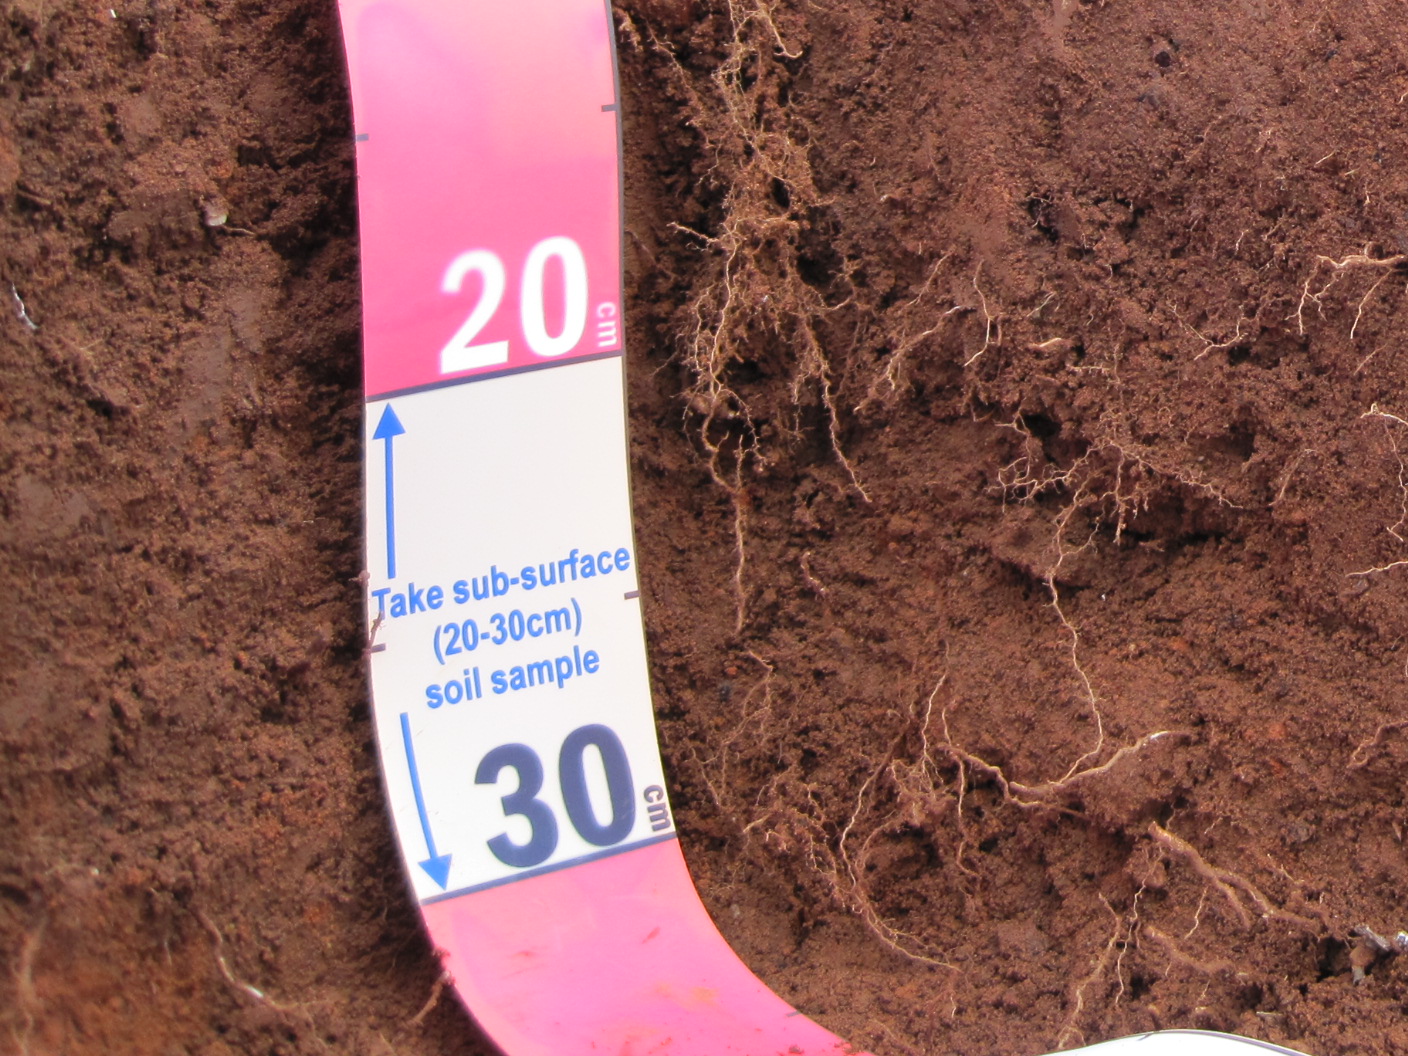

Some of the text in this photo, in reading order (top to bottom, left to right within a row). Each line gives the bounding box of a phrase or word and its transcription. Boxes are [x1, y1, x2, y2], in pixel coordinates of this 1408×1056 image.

[440, 236, 617, 374] 20 cm
[371, 547, 631, 619] Take sub-surface
[433, 597, 583, 665] (20-30cm)
[425, 645, 601, 710] soil sample
[474, 723, 671, 868] 30 cm
